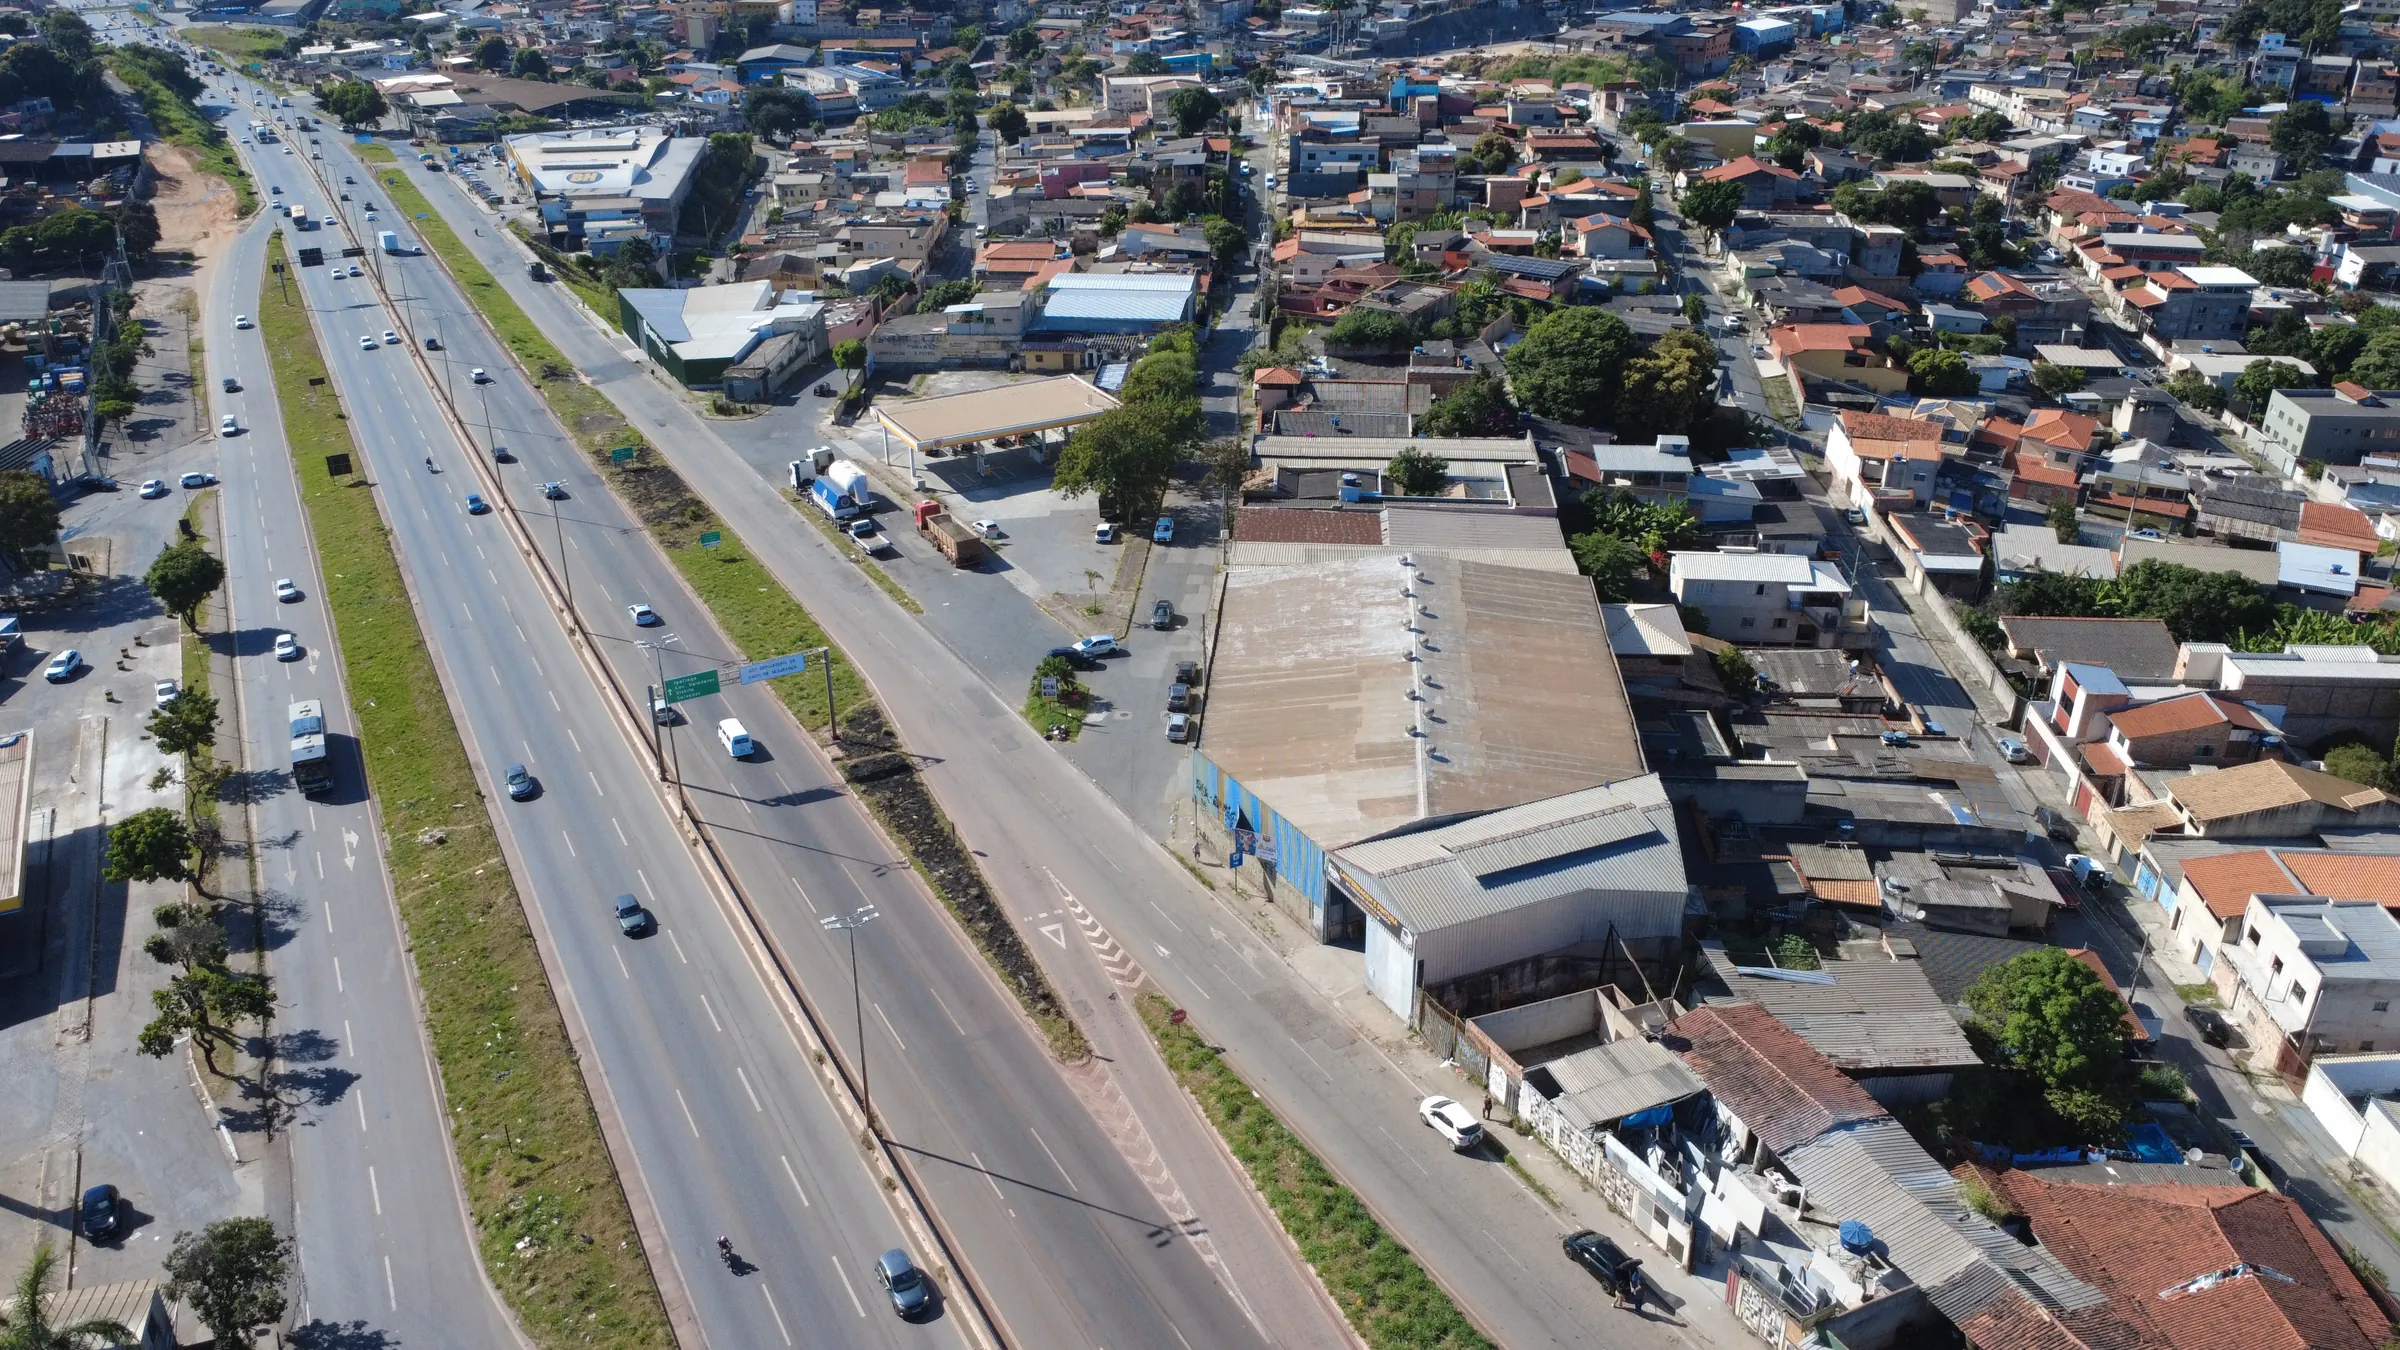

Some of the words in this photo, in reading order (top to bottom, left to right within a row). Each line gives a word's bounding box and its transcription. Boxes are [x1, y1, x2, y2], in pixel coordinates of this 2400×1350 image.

[570, 173, 597, 182] BH
[677, 691, 701, 700] Salvador
[1377, 903, 1399, 927] PINTURA
